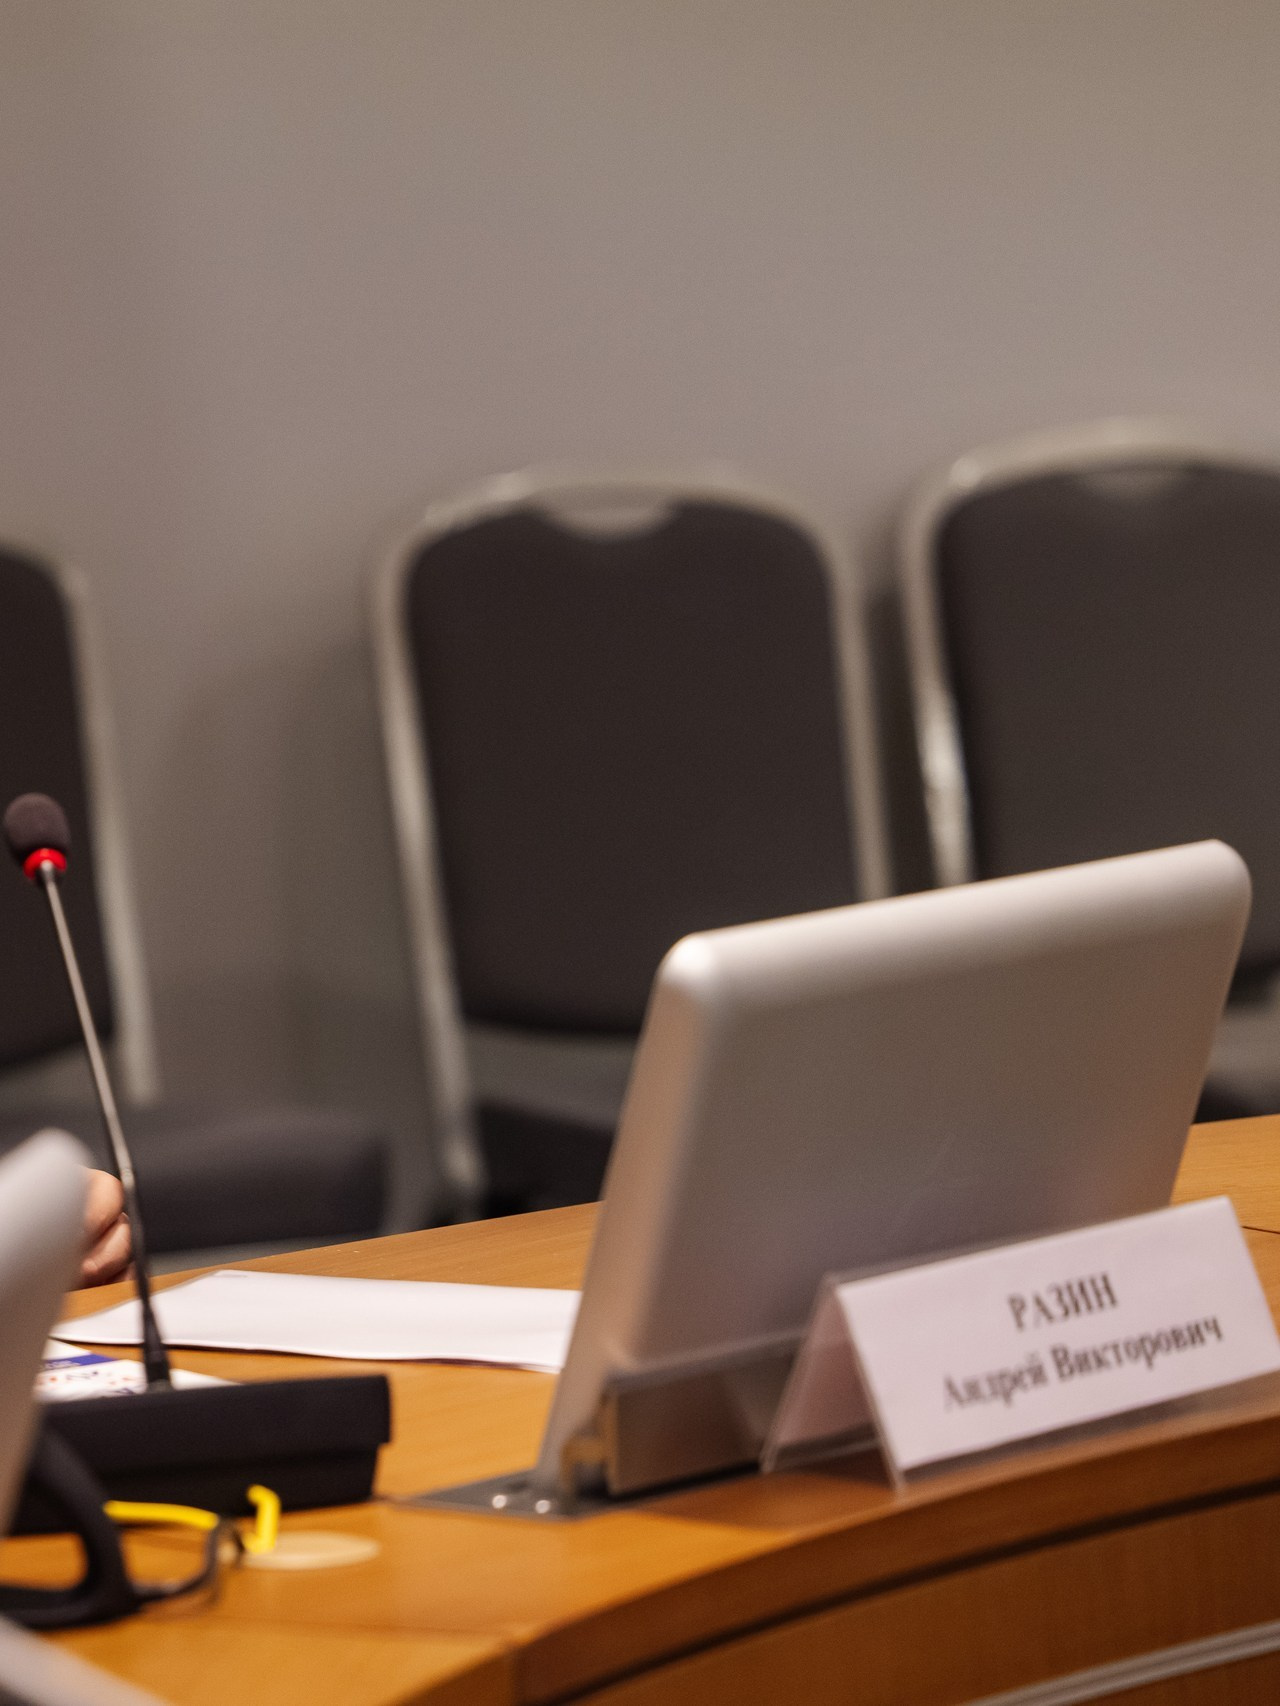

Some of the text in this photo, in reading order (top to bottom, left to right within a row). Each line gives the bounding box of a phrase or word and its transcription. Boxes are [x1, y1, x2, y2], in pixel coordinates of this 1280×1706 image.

[1008, 1273, 1118, 1331] РАЗИН
[944, 1317, 1224, 1408] Андрей Викторович
